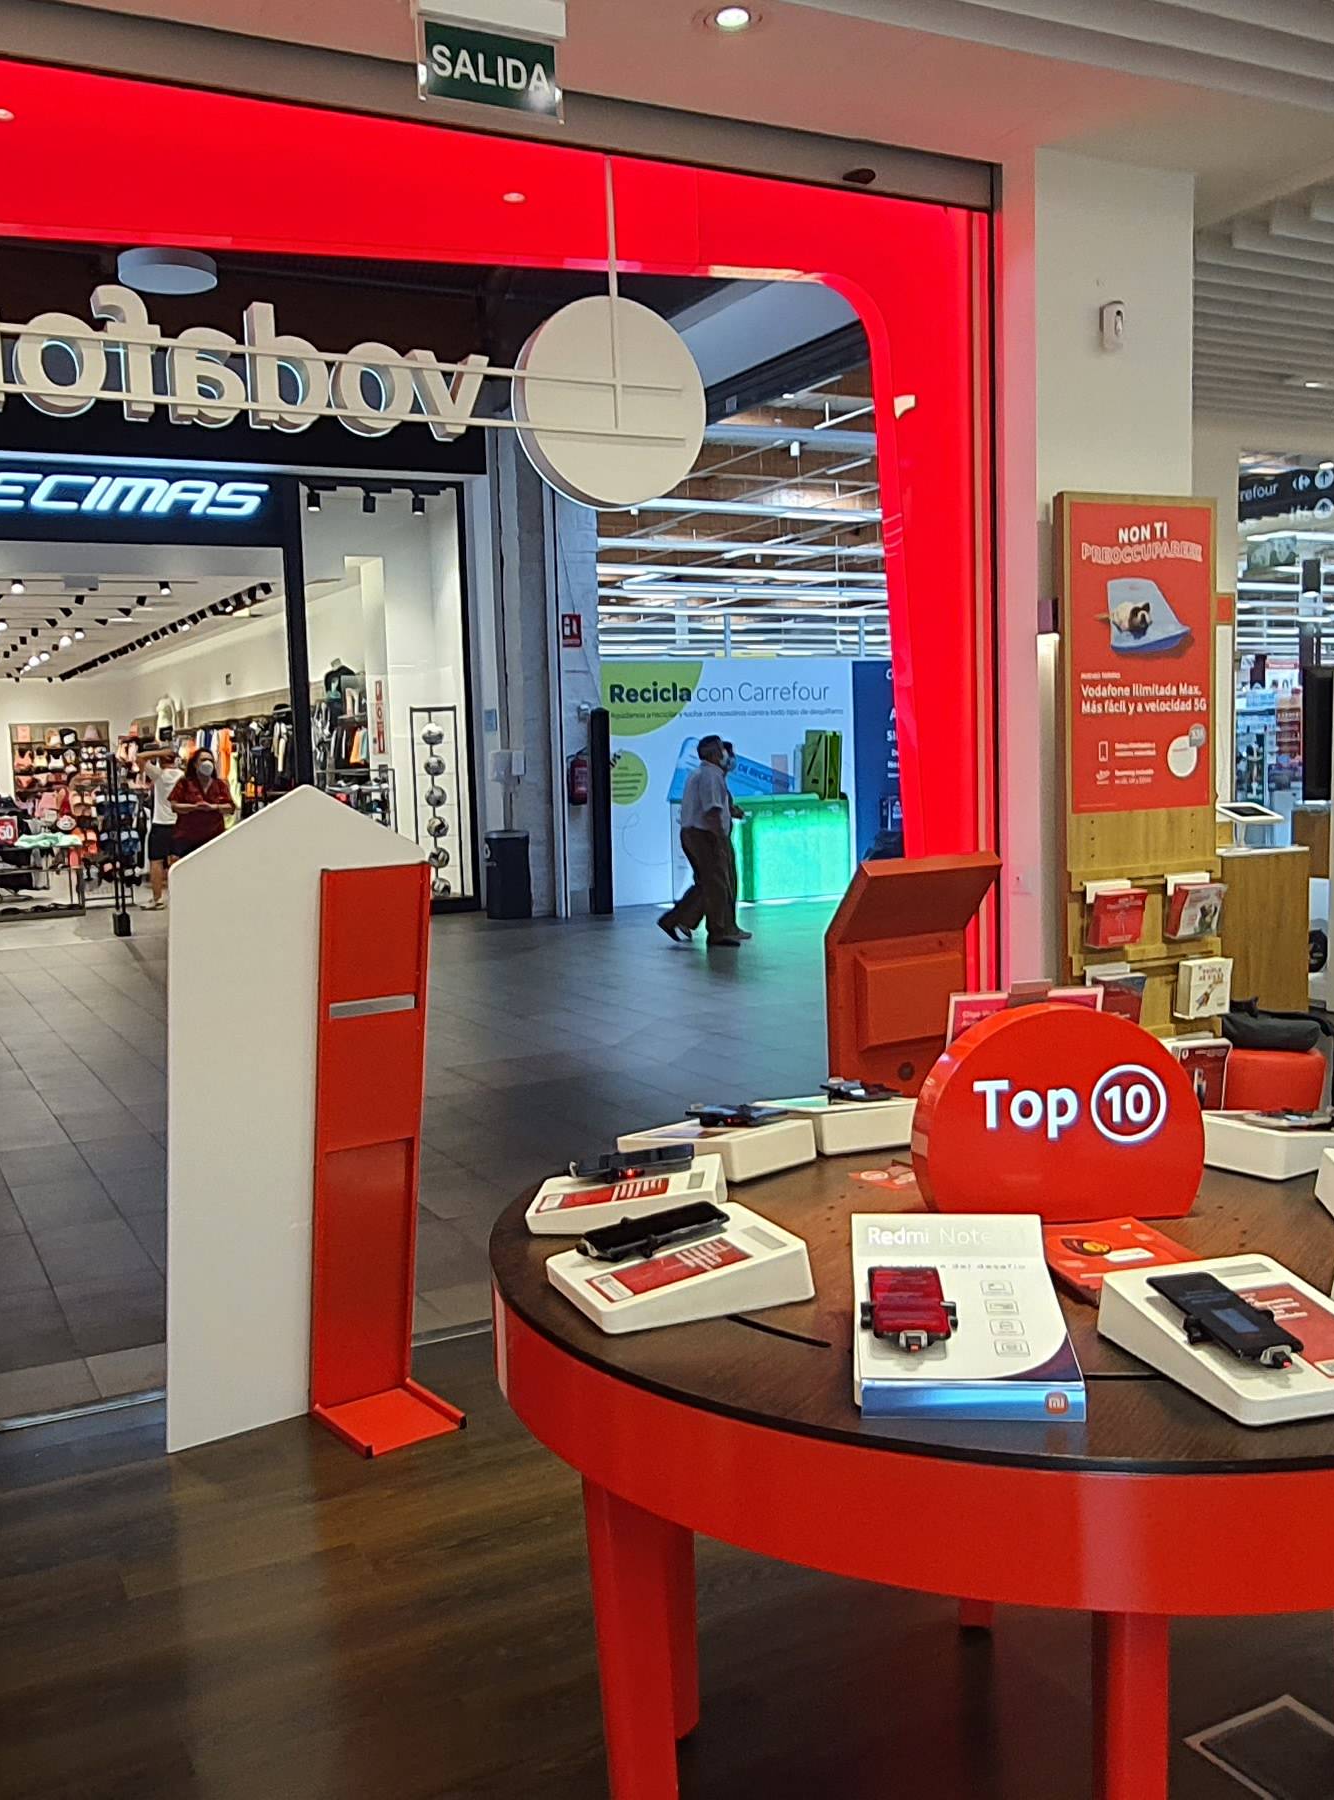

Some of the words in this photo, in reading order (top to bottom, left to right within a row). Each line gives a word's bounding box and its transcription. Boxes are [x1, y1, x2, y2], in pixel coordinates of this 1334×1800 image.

[431, 44, 550, 93] SALIDA
[1240, 482, 1279, 502] refour
[1118, 523, 1151, 544] NON
[1154, 521, 1167, 539] TI
[610, 681, 691, 703] Recicla
[696, 686, 733, 702] con
[738, 681, 830, 701] Carrefour
[1081, 683, 1130, 697] Vodafone
[1132, 683, 1177, 697] Ilimitada
[1179, 682, 1202, 696] Max.
[1081, 700, 1102, 714] Más
[1105, 699, 1126, 713] fácil
[1128, 701, 1135, 715] y
[1137, 702, 1143, 712] a
[1144, 698, 1192, 712] velocidad
[1194, 697, 1207, 711] 5G
[973, 1079, 1078, 1139] Top
[1104, 1084, 1151, 1122] 10
[867, 1226, 929, 1246] Redmi
[939, 1228, 993, 1246] Note
